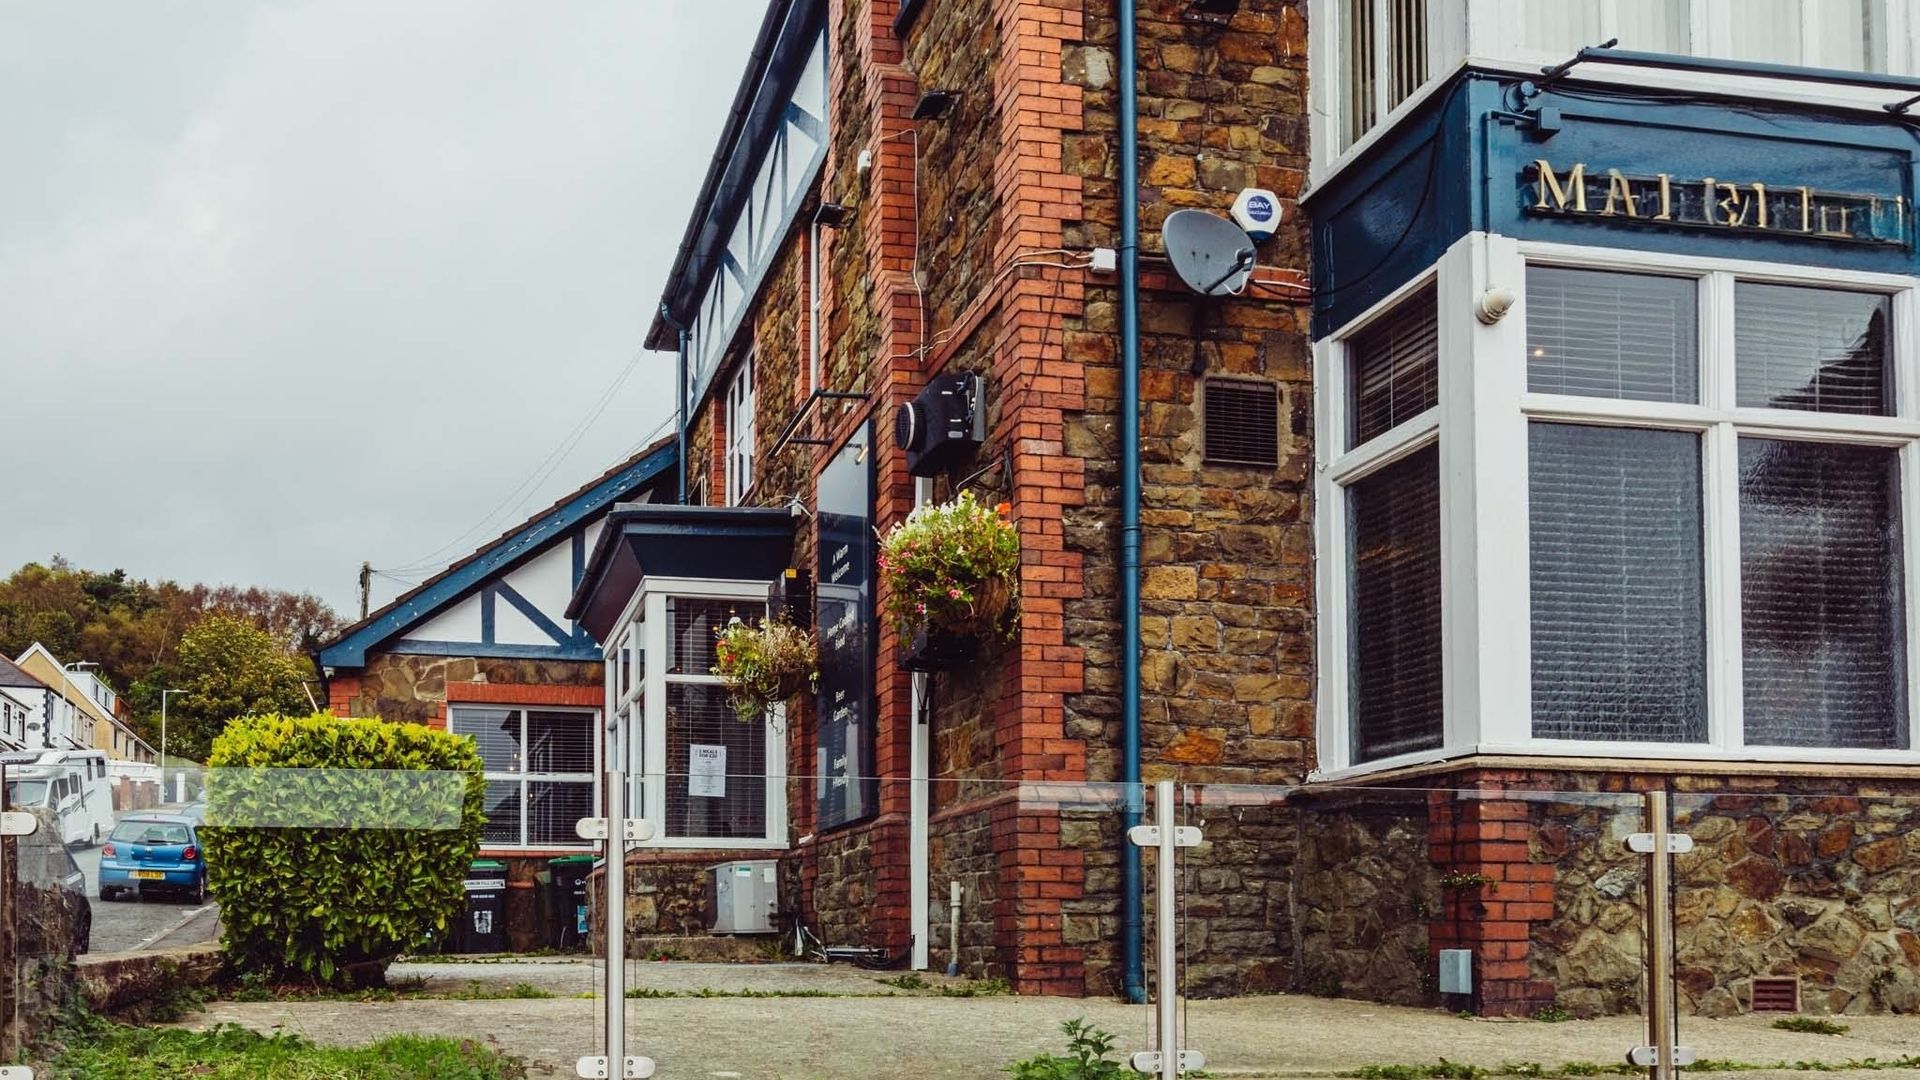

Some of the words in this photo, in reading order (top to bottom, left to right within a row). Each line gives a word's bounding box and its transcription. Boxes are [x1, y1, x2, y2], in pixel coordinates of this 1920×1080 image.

[1248, 201, 1270, 210] BAY
[836, 544, 849, 562] Warm
[831, 562, 850, 583] Welcome
[835, 689, 845, 703] Beer
[833, 706, 848, 721] Garden
